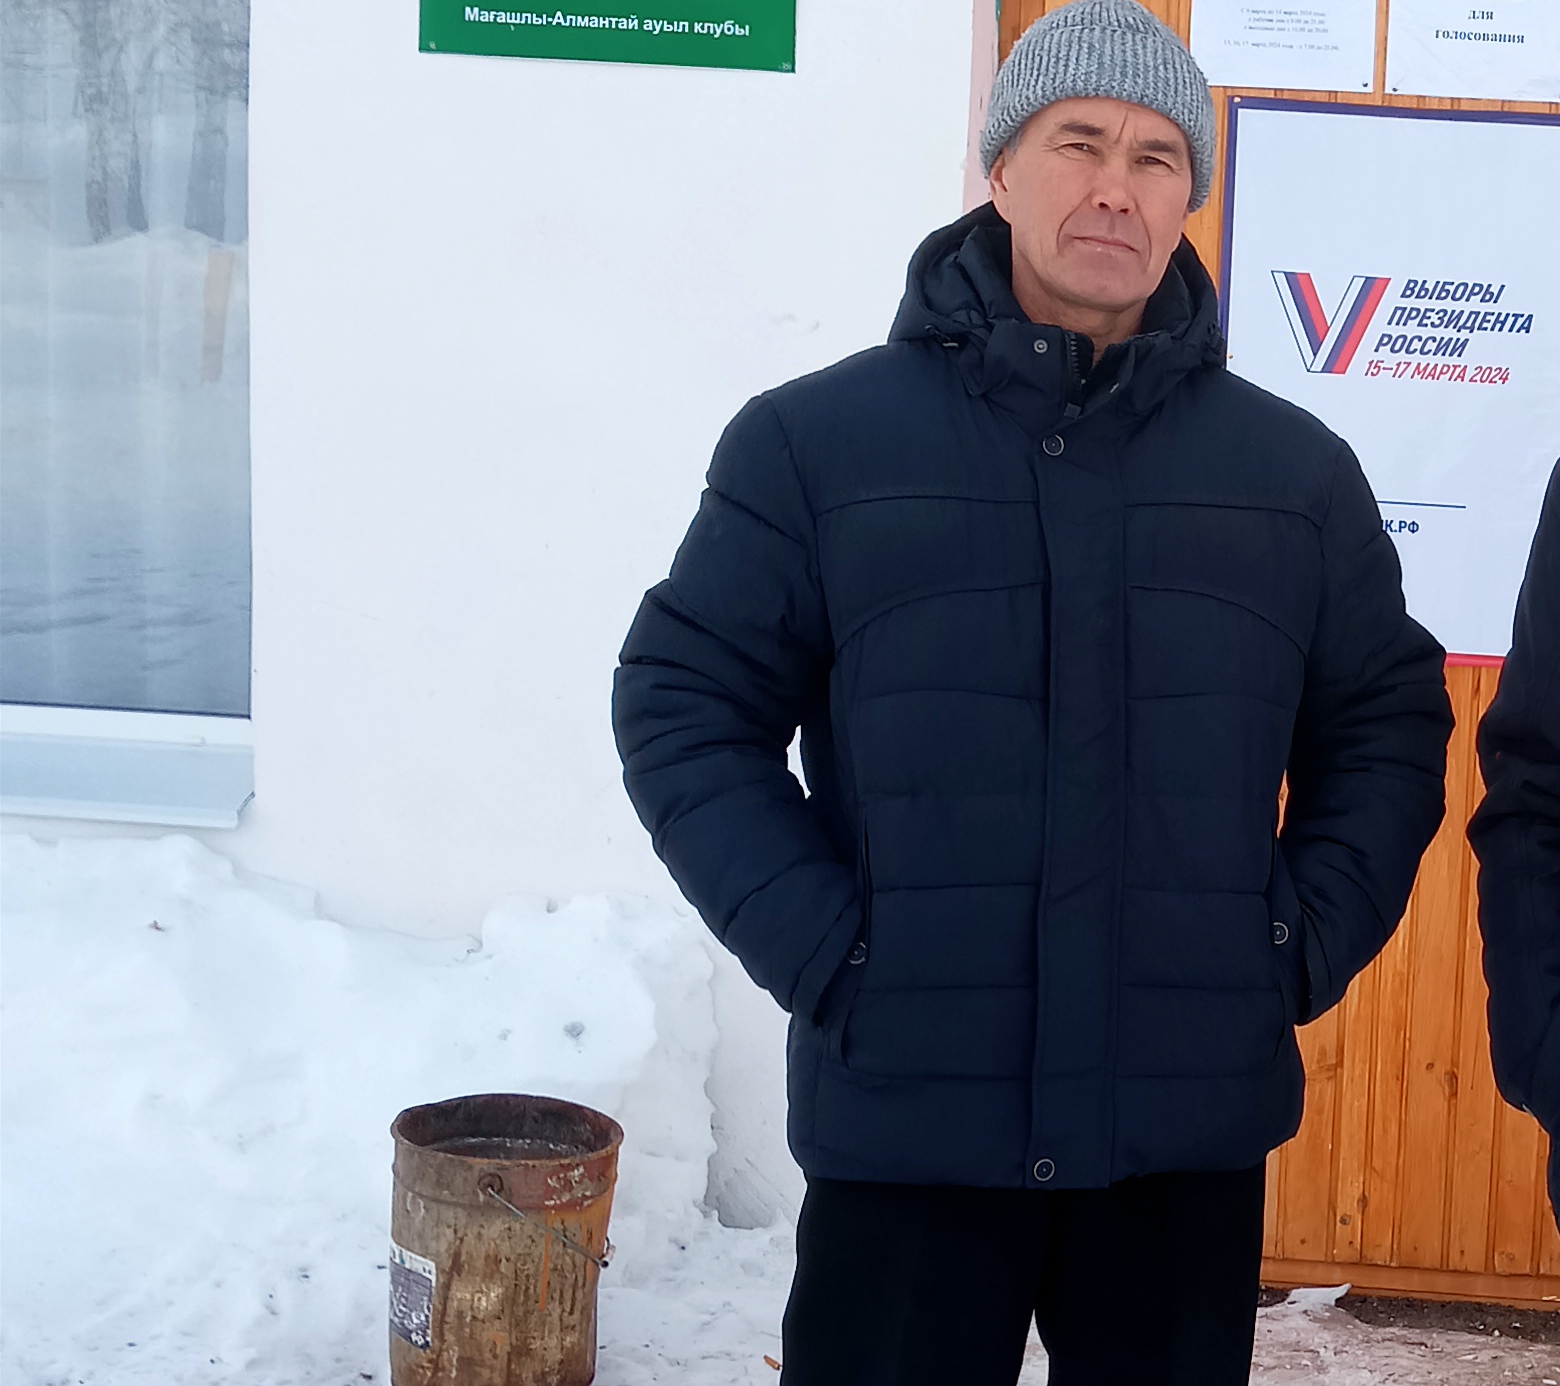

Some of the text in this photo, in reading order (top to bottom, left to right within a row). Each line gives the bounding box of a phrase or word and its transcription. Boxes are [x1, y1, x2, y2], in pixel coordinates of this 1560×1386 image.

[1467, 9, 1494, 21] для
[643, 18, 690, 35] ауыл
[693, 19, 750, 38] клубы
[1434, 29, 1525, 45] голосования
[1400, 278, 1506, 304] ВЫБОРЫ
[1387, 306, 1534, 334] ПРЕЗИДЕНТА
[1374, 333, 1470, 358] РОССИИ
[1410, 362, 1468, 382] МАРТА
[1469, 365, 1511, 385] 2024
[1381, 519, 1420, 534] К.РФ
